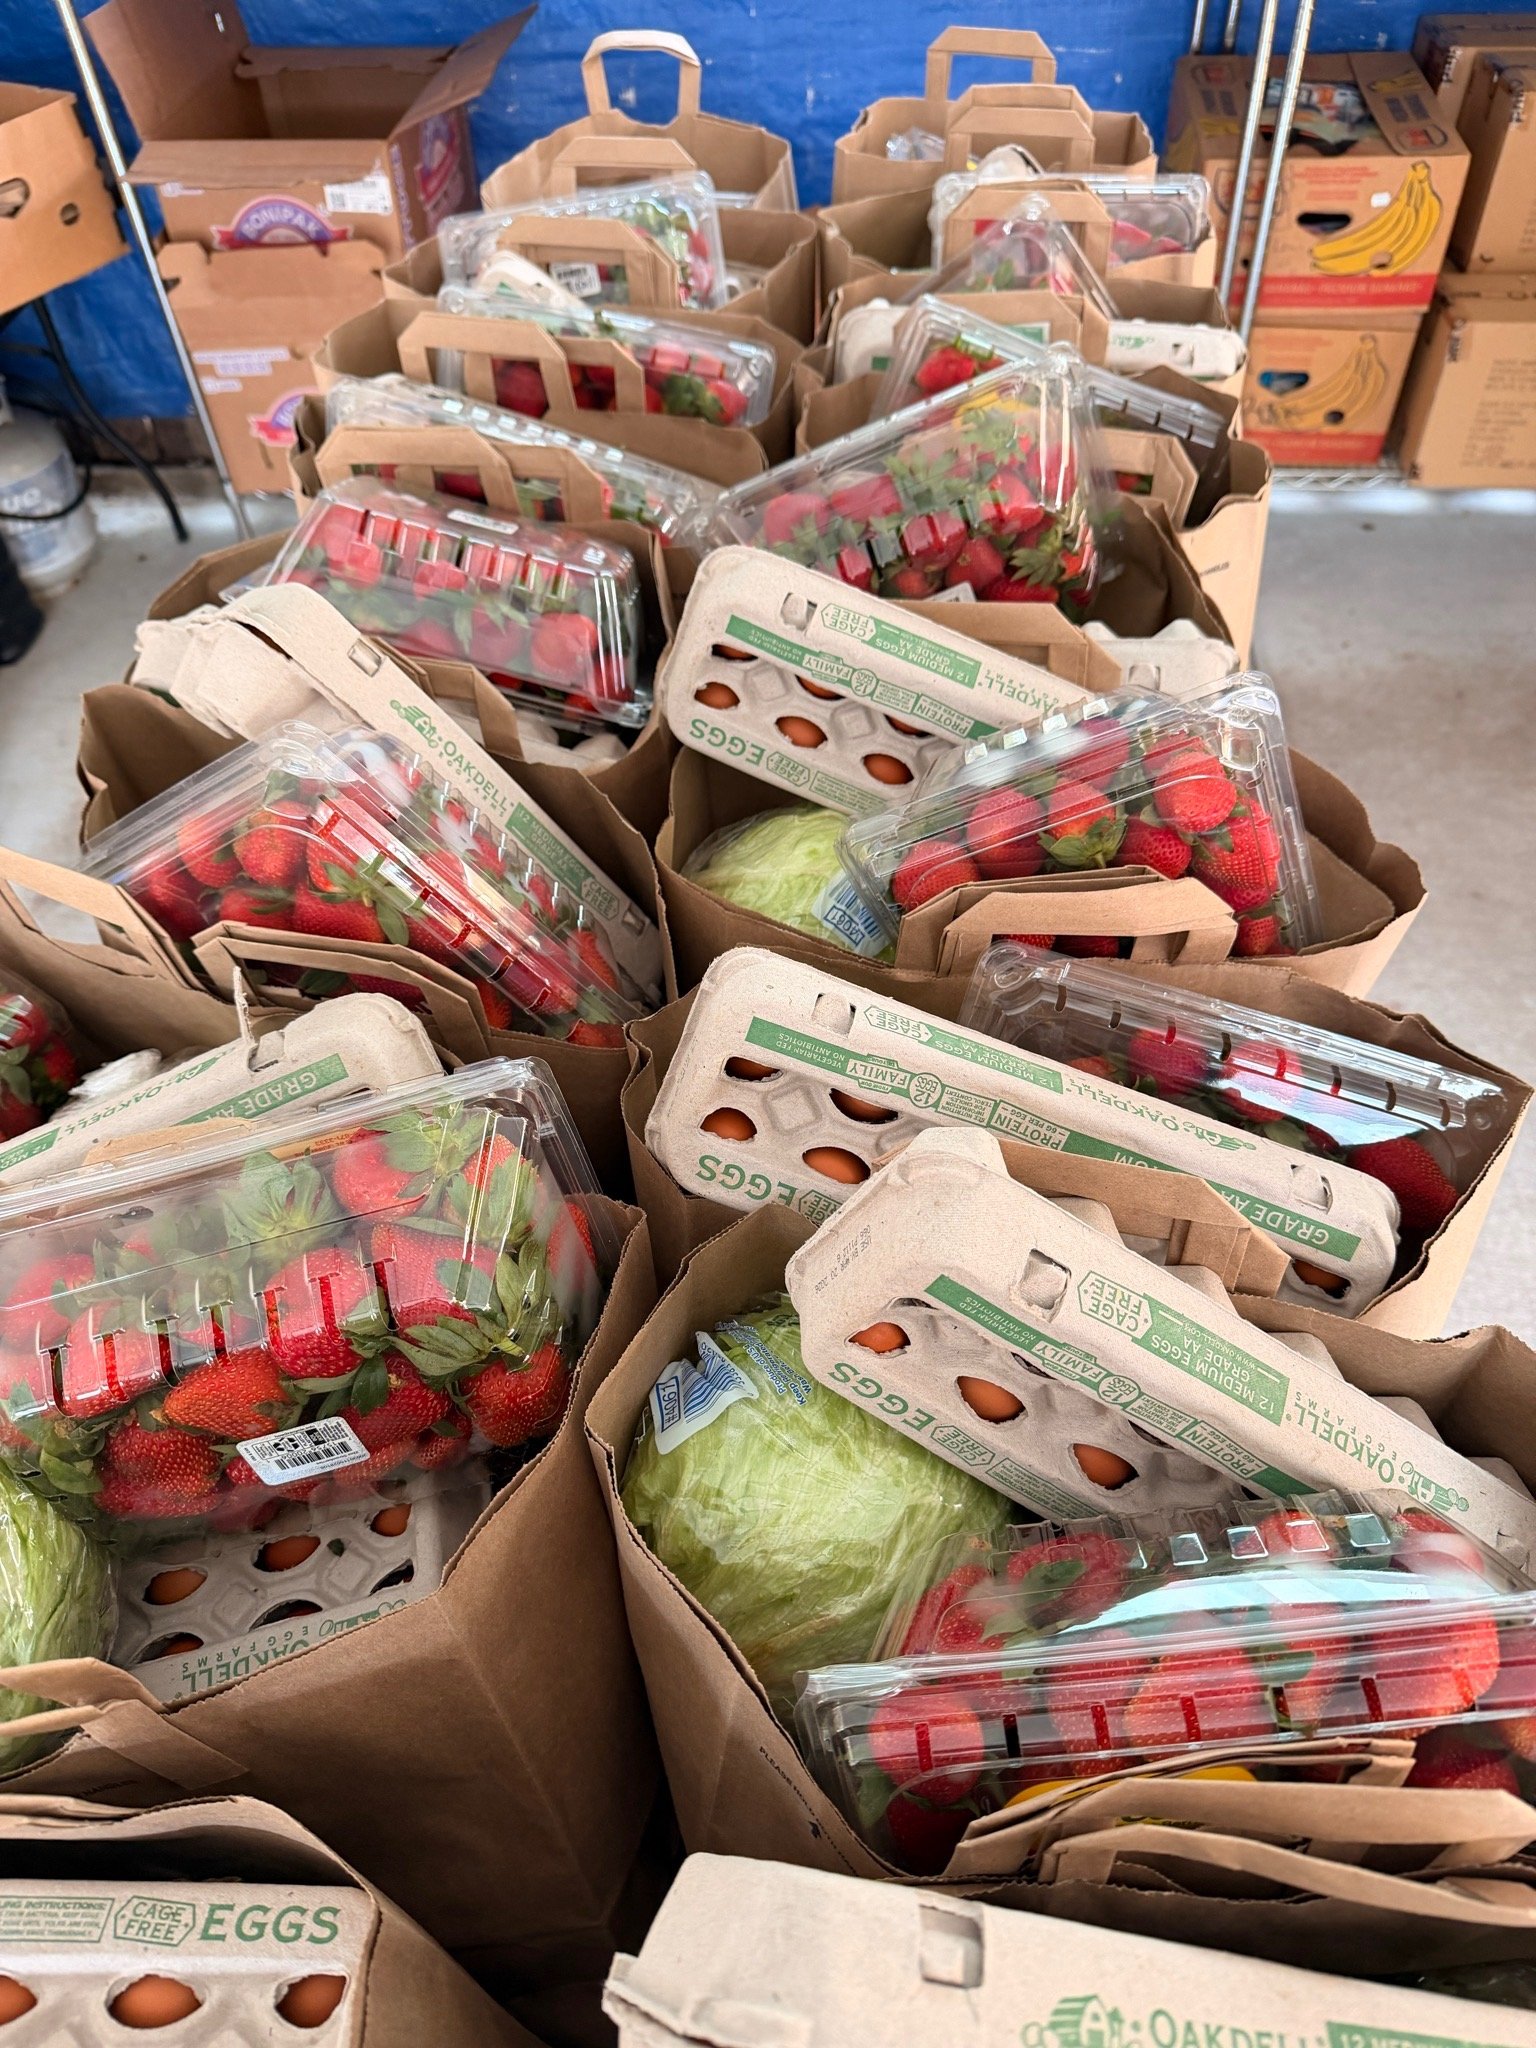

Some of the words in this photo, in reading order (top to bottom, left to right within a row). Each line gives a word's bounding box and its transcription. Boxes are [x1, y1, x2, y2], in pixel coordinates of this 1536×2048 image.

[241, 206, 320, 239] BONIPAK
[827, 614, 867, 640] CAGE
[829, 604, 869, 630] FREE
[874, 636, 906, 657] EGGS
[896, 637, 913, 650] AA
[913, 643, 951, 667] GRADE
[803, 655, 850, 679] FAMILY
[907, 648, 955, 678] MEDIUM
[853, 679, 870, 695] 12
[854, 671, 873, 686] EGGS
[954, 669, 970, 683] 12
[981, 672, 1055, 718] AKDELL
[915, 702, 969, 734] PROTEIN
[686, 716, 766, 766] EGGS
[441, 739, 513, 811] OAKDELL
[770, 762, 801, 782] CAGE
[775, 755, 806, 775] FREE
[517, 808, 531, 822] 12
[529, 821, 565, 856] MEDIUM
[562, 854, 587, 878] EGGS
[529, 832, 557, 859] GRADE
[555, 857, 568, 870] AA
[582, 889, 613, 916] FREE
[588, 880, 616, 906] CAGE
[875, 1016, 923, 1038] CAGE
[876, 1010, 922, 1031] FREE
[775, 1039, 791, 1050] FED
[778, 1032, 832, 1056] ANTIBIOTICS
[933, 1038, 972, 1058] EGGS
[960, 1042, 977, 1053] AA
[793, 1045, 842, 1068] VEGETARIAN
[832, 1052, 844, 1060] NO
[975, 1053, 1034, 1080] MEDIUM
[981, 1049, 1026, 1070] GRADE
[848, 1061, 907, 1086] FAMILY
[914, 1075, 938, 1093] EGGS
[1038, 1076, 1055, 1088] 12
[238, 1069, 318, 1116] GRADE
[912, 1088, 932, 1105] 12
[945, 1088, 972, 1101] CONTENT
[972, 1097, 992, 1107] TEROL
[63, 1084, 163, 1136] OAKDELL
[940, 1103, 971, 1118] NUTRITION
[945, 1099, 984, 1116] INFORMATION
[972, 1103, 985, 1111] FOR
[1008, 1108, 1027, 1121] EGG
[1068, 1083, 1180, 1131] OAKDELL
[994, 1112, 1062, 1150] PROTEIN
[1026, 1116, 1045, 1129] PER
[1045, 1124, 1057, 1133] 6G
[692, 1152, 798, 1211] EGGS
[1249, 1202, 1330, 1247] GRADE
[958, 1300, 976, 1315] FED
[1086, 1277, 1146, 1316] FREE
[963, 1294, 1022, 1333] ANTIBIOTICS
[1084, 1296, 1141, 1332] CAGE
[977, 1311, 1029, 1345] VEGETARIAN
[1022, 1329, 1036, 1341] NO
[1148, 1333, 1193, 1365] EGGS
[1179, 1334, 1201, 1354] AA
[755, 1356, 766, 1365] of
[755, 1341, 790, 1383] Refrigerated
[1034, 1340, 1103, 1381] FAMILY
[1201, 1347, 1252, 1383] GRADE
[761, 1363, 786, 1394] Produce
[791, 1372, 812, 1394] Wash
[1108, 1374, 1136, 1397] EGGS
[1193, 1358, 1257, 1401] MEDIUM
[660, 1383, 677, 1423] #4061
[788, 1381, 806, 1405] Keep
[827, 1360, 937, 1432] EGGS
[1101, 1385, 1124, 1403] 12
[1139, 1392, 1171, 1415] CONTENT
[1258, 1395, 1278, 1414] 12
[1130, 1404, 1163, 1427] NUTRITION
[1135, 1403, 1178, 1429] INFORMATION
[1168, 1414, 1182, 1426] FOR
[1170, 1410, 1190, 1424] TEROL
[1292, 1390, 1357, 1434] FARMS
[1162, 1422, 1176, 1433] SEE
[1207, 1429, 1226, 1444] EGG
[938, 1433, 977, 1463] CAGE
[946, 1427, 988, 1459] FREE
[1185, 1427, 1255, 1478] PROTEIN
[1225, 1441, 1243, 1456] PER
[1285, 1400, 1400, 1485] OAKDELL
[1362, 1433, 1399, 1460] EGG
[1242, 1453, 1255, 1464] 6G
[266, 1625, 310, 1647] EGG
[179, 1641, 257, 1673] FARMS
[759, 1746, 792, 1786] PLEASE
[24, 1900, 105, 1910] INSTRUCTIONS:
[132, 1901, 186, 1924] CAGE
[123, 1919, 176, 1942] FREE
[200, 1903, 341, 1944] EGGS
